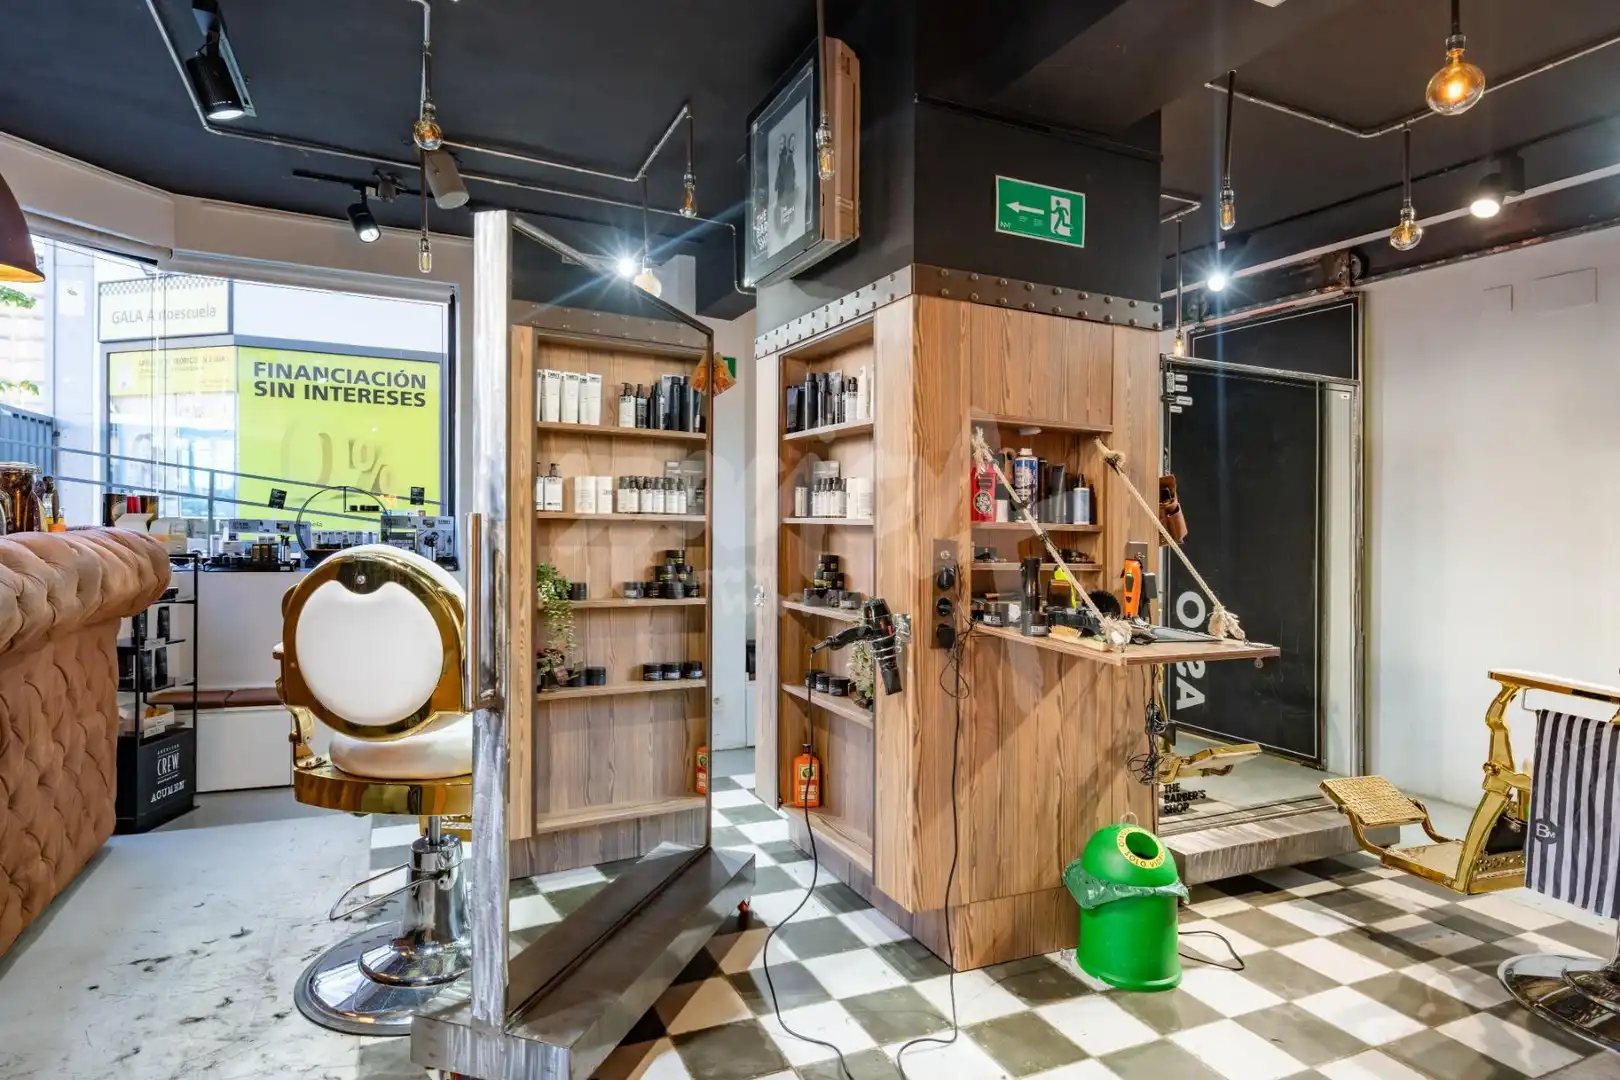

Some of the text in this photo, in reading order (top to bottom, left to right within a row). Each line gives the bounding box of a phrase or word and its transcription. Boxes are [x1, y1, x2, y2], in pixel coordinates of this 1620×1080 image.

[111, 309, 143, 325] GALA
[254, 361, 426, 389] FINANCIACIÓN
[254, 380, 426, 408] SIN INTERESES
[157, 752, 180, 776] CREW
[150, 780, 185, 803] ACUMEN
[1163, 782, 1180, 794] THE
[1163, 789, 1207, 804] BARBER'S
[1163, 802, 1190, 815] SHOP
